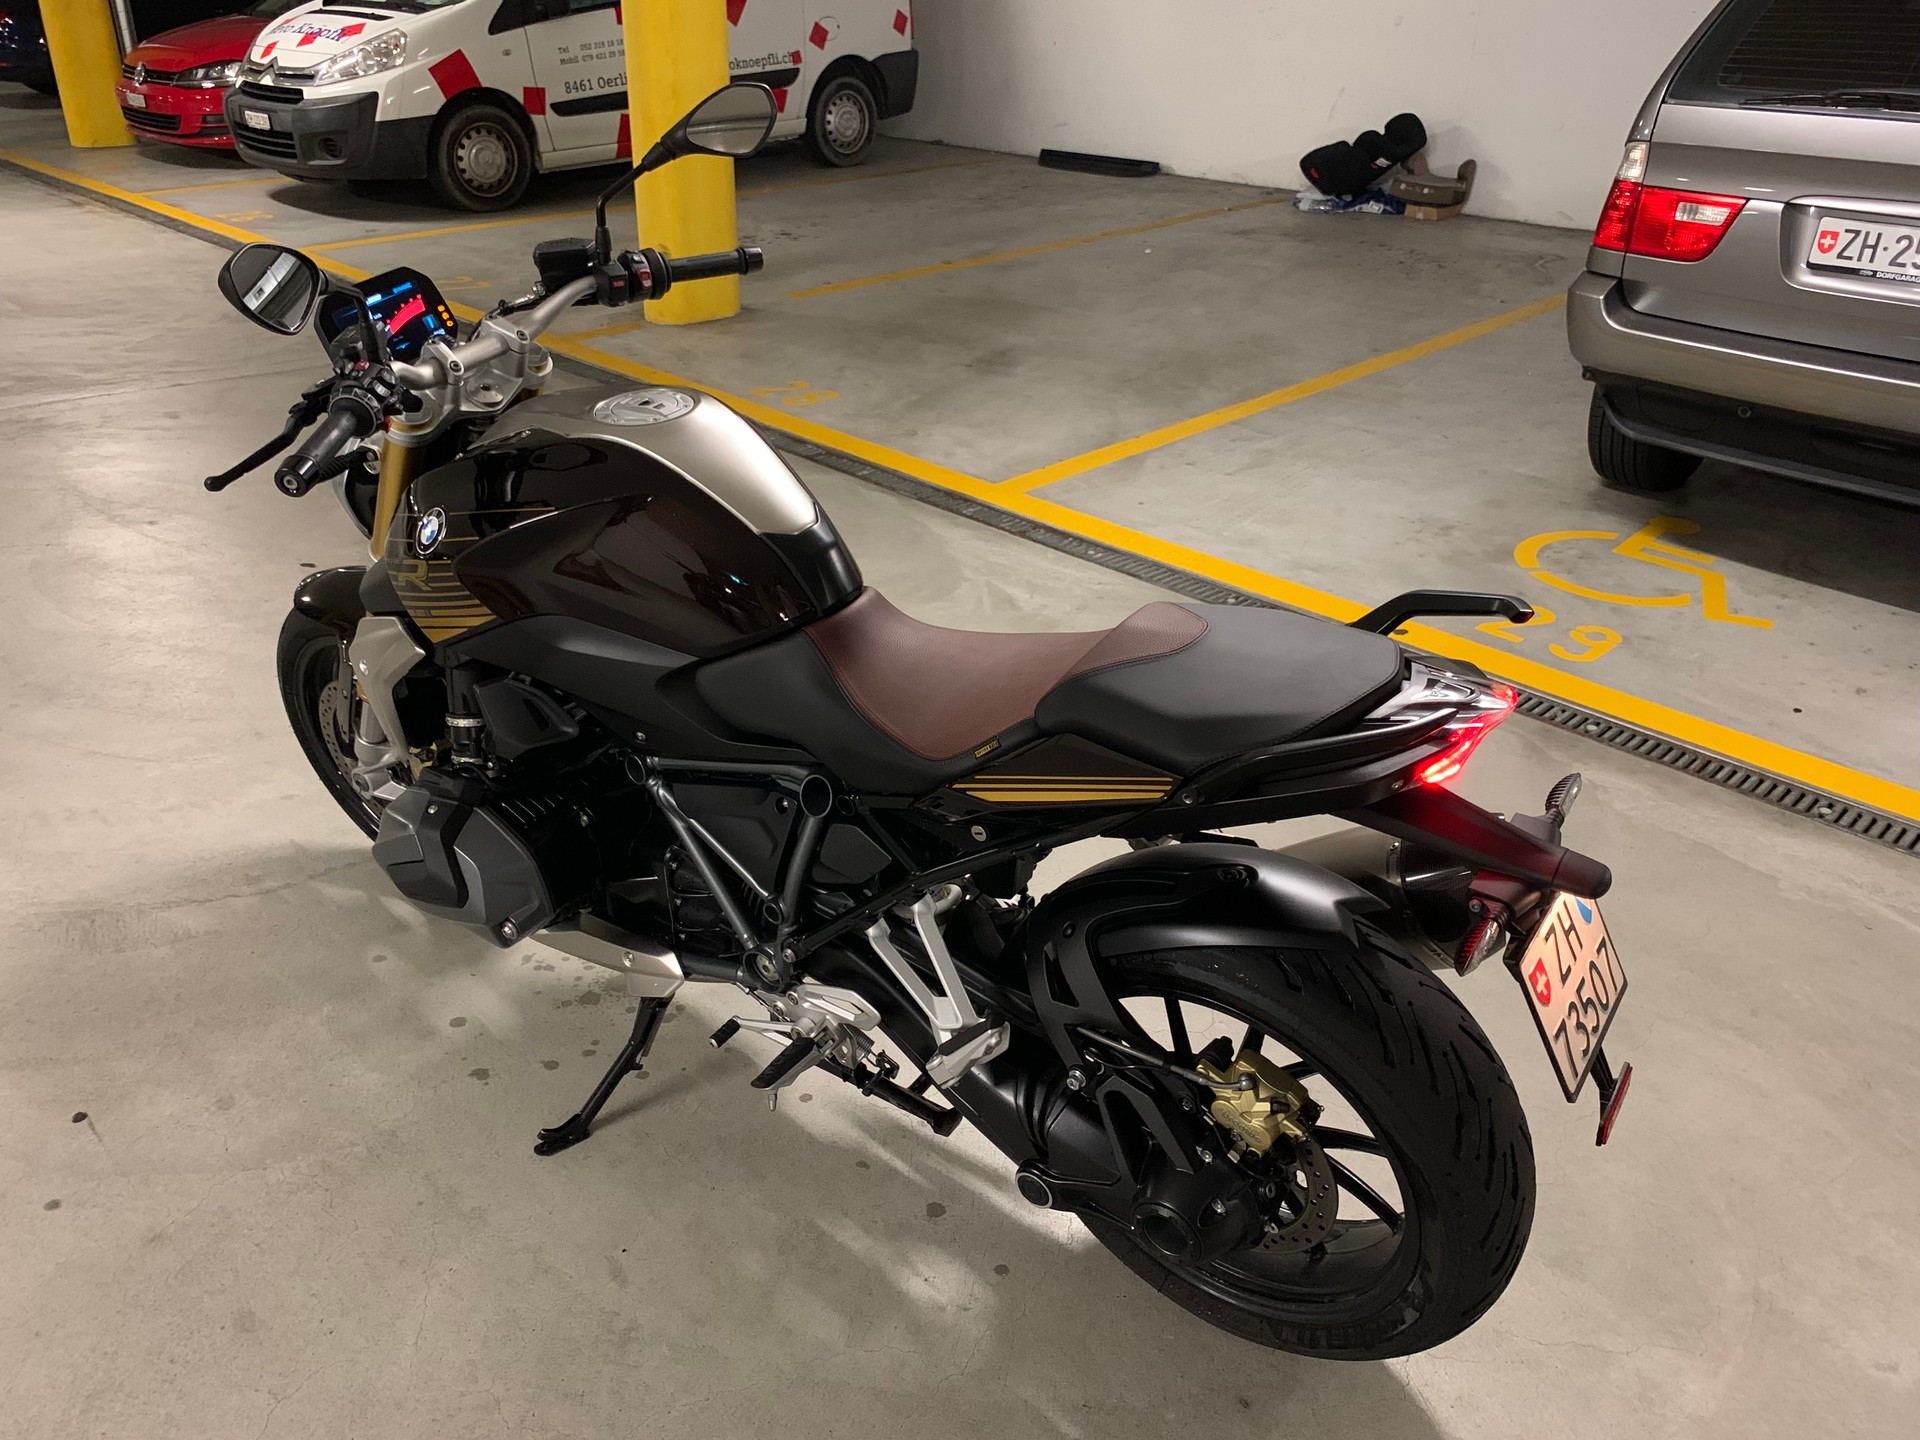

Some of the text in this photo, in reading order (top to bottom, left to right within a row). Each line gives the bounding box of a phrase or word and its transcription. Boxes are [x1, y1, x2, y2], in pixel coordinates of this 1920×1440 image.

[558, 45, 570, 54] Tel
[564, 72, 628, 94] 8461 Oerli
[1475, 605, 1622, 662] 29
[1543, 899, 1583, 989] ZH
[1553, 936, 1618, 1079] 73507
